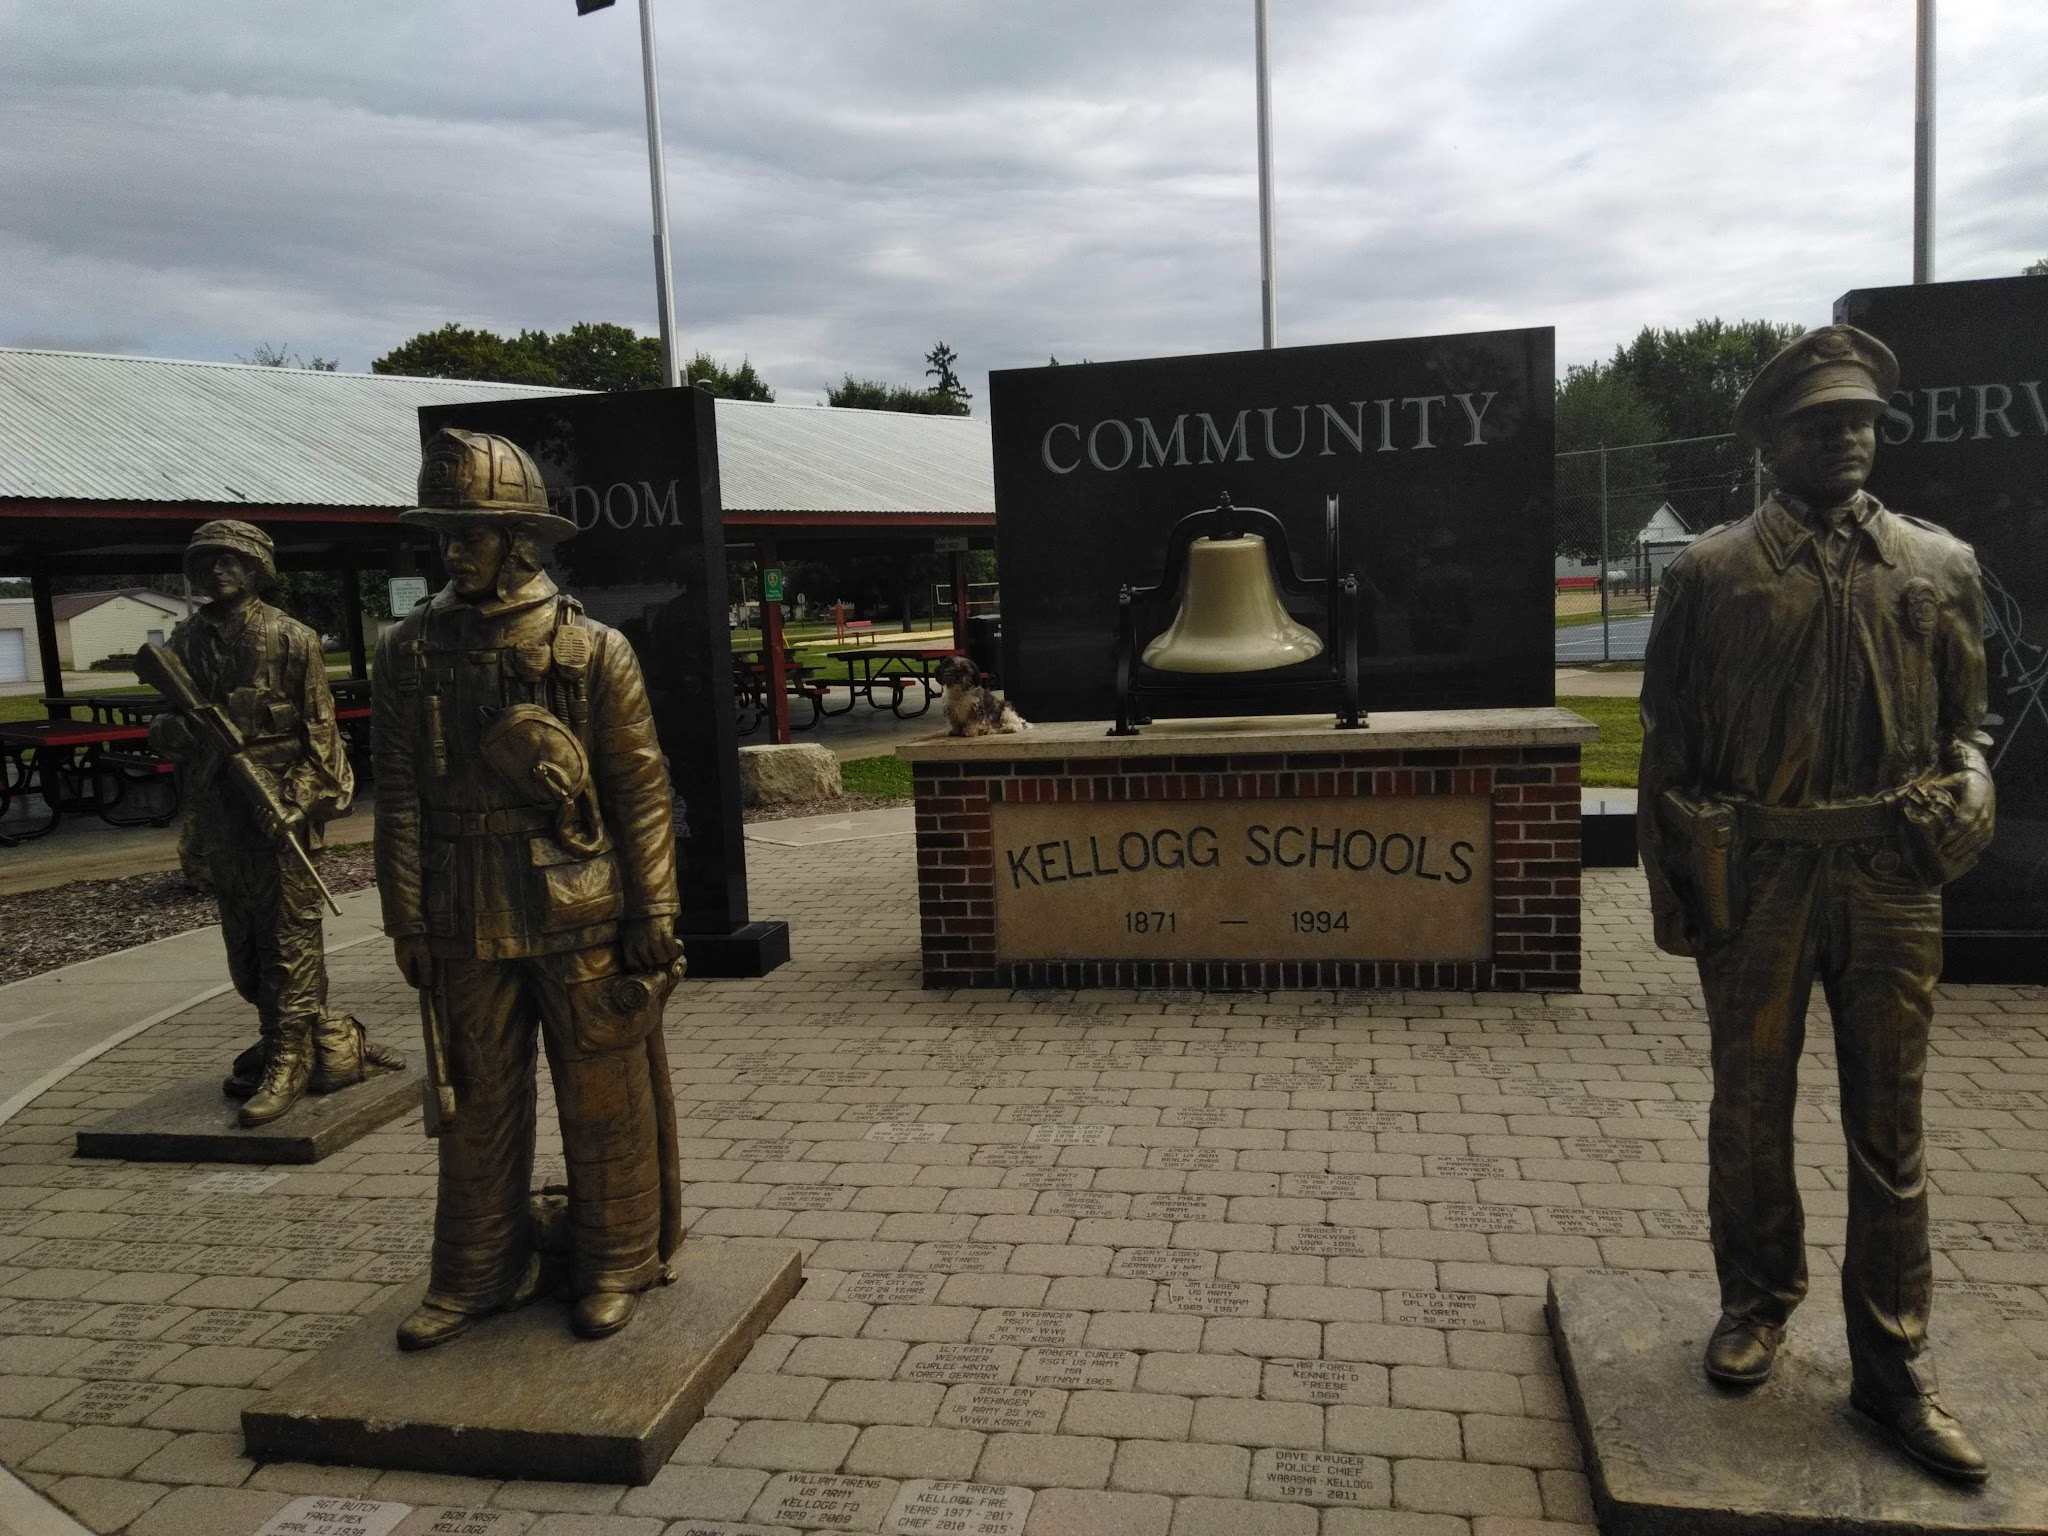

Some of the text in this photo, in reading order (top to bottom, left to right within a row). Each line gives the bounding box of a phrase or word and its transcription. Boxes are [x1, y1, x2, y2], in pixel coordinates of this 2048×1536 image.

[1041, 390, 1498, 475] COMMUNITY
[549, 479, 685, 531] DOM
[1006, 823, 1476, 890] KELLOGG SCHOOLS
[1124, 911, 1177, 934] 1871
[1290, 911, 1350, 934] 1994
[1207, 1297, 1249, 1305] VIETNAM
[1402, 1291, 1477, 1302] FLOYD LEWIS
[1002, 1310, 1016, 1318] ED
[1004, 1317, 1063, 1327] MSGT USMC
[1013, 1326, 1034, 1334] YRS
[1039, 1327, 1066, 1336] WWII
[1030, 1336, 1065, 1344] KOREA
[962, 1346, 993, 1354] FAITH
[1037, 1349, 1127, 1360] ROBERT CURLEE
[934, 1353, 989, 1363] WEHINGER
[1039, 1358, 1121, 1368] SSGT US ARMY
[1064, 1367, 1082, 1375] MIA
[1296, 1361, 1357, 1373] AIR FORCE
[908, 1371, 999, 1380] KOREA GERMANY
[1035, 1375, 1080, 1385] VIETNAM
[1293, 1370, 1345, 1381] KENNETH
[1302, 1380, 1349, 1390] FREESE
[979, 1387, 1036, 1398] SSGT ERV
[972, 1396, 1030, 1407] WEHINGER
[952, 1405, 1047, 1419] US ARMY 25 YRS
[959, 1415, 1032, 1427] WWII KOREA
[1275, 1451, 1365, 1466] DAVE KRUGER
[1276, 1463, 1364, 1476] POLICE CHIEF
[788, 1475, 881, 1489] WILLIAM ARENS
[1266, 1473, 1374, 1490] WABASHA KELLOGG
[800, 1487, 855, 1498] US ARMY
[928, 1483, 1006, 1495] JEFF ARENS
[313, 1500, 381, 1512] SGT BUTCH
[780, 1499, 860, 1512] KELLOGG FD
[917, 1493, 1008, 1508] KELLOGG FIRE
[440, 1511, 501, 1523] BOB IRISH
[903, 1505, 1013, 1520] YEARS 1977 2017
[278, 1523, 307, 1534] APRIL
[316, 1525, 331, 1535] 12
[431, 1523, 488, 1535] KELLOGG
[898, 1518, 1009, 1533] CHIEF 2010 2015
